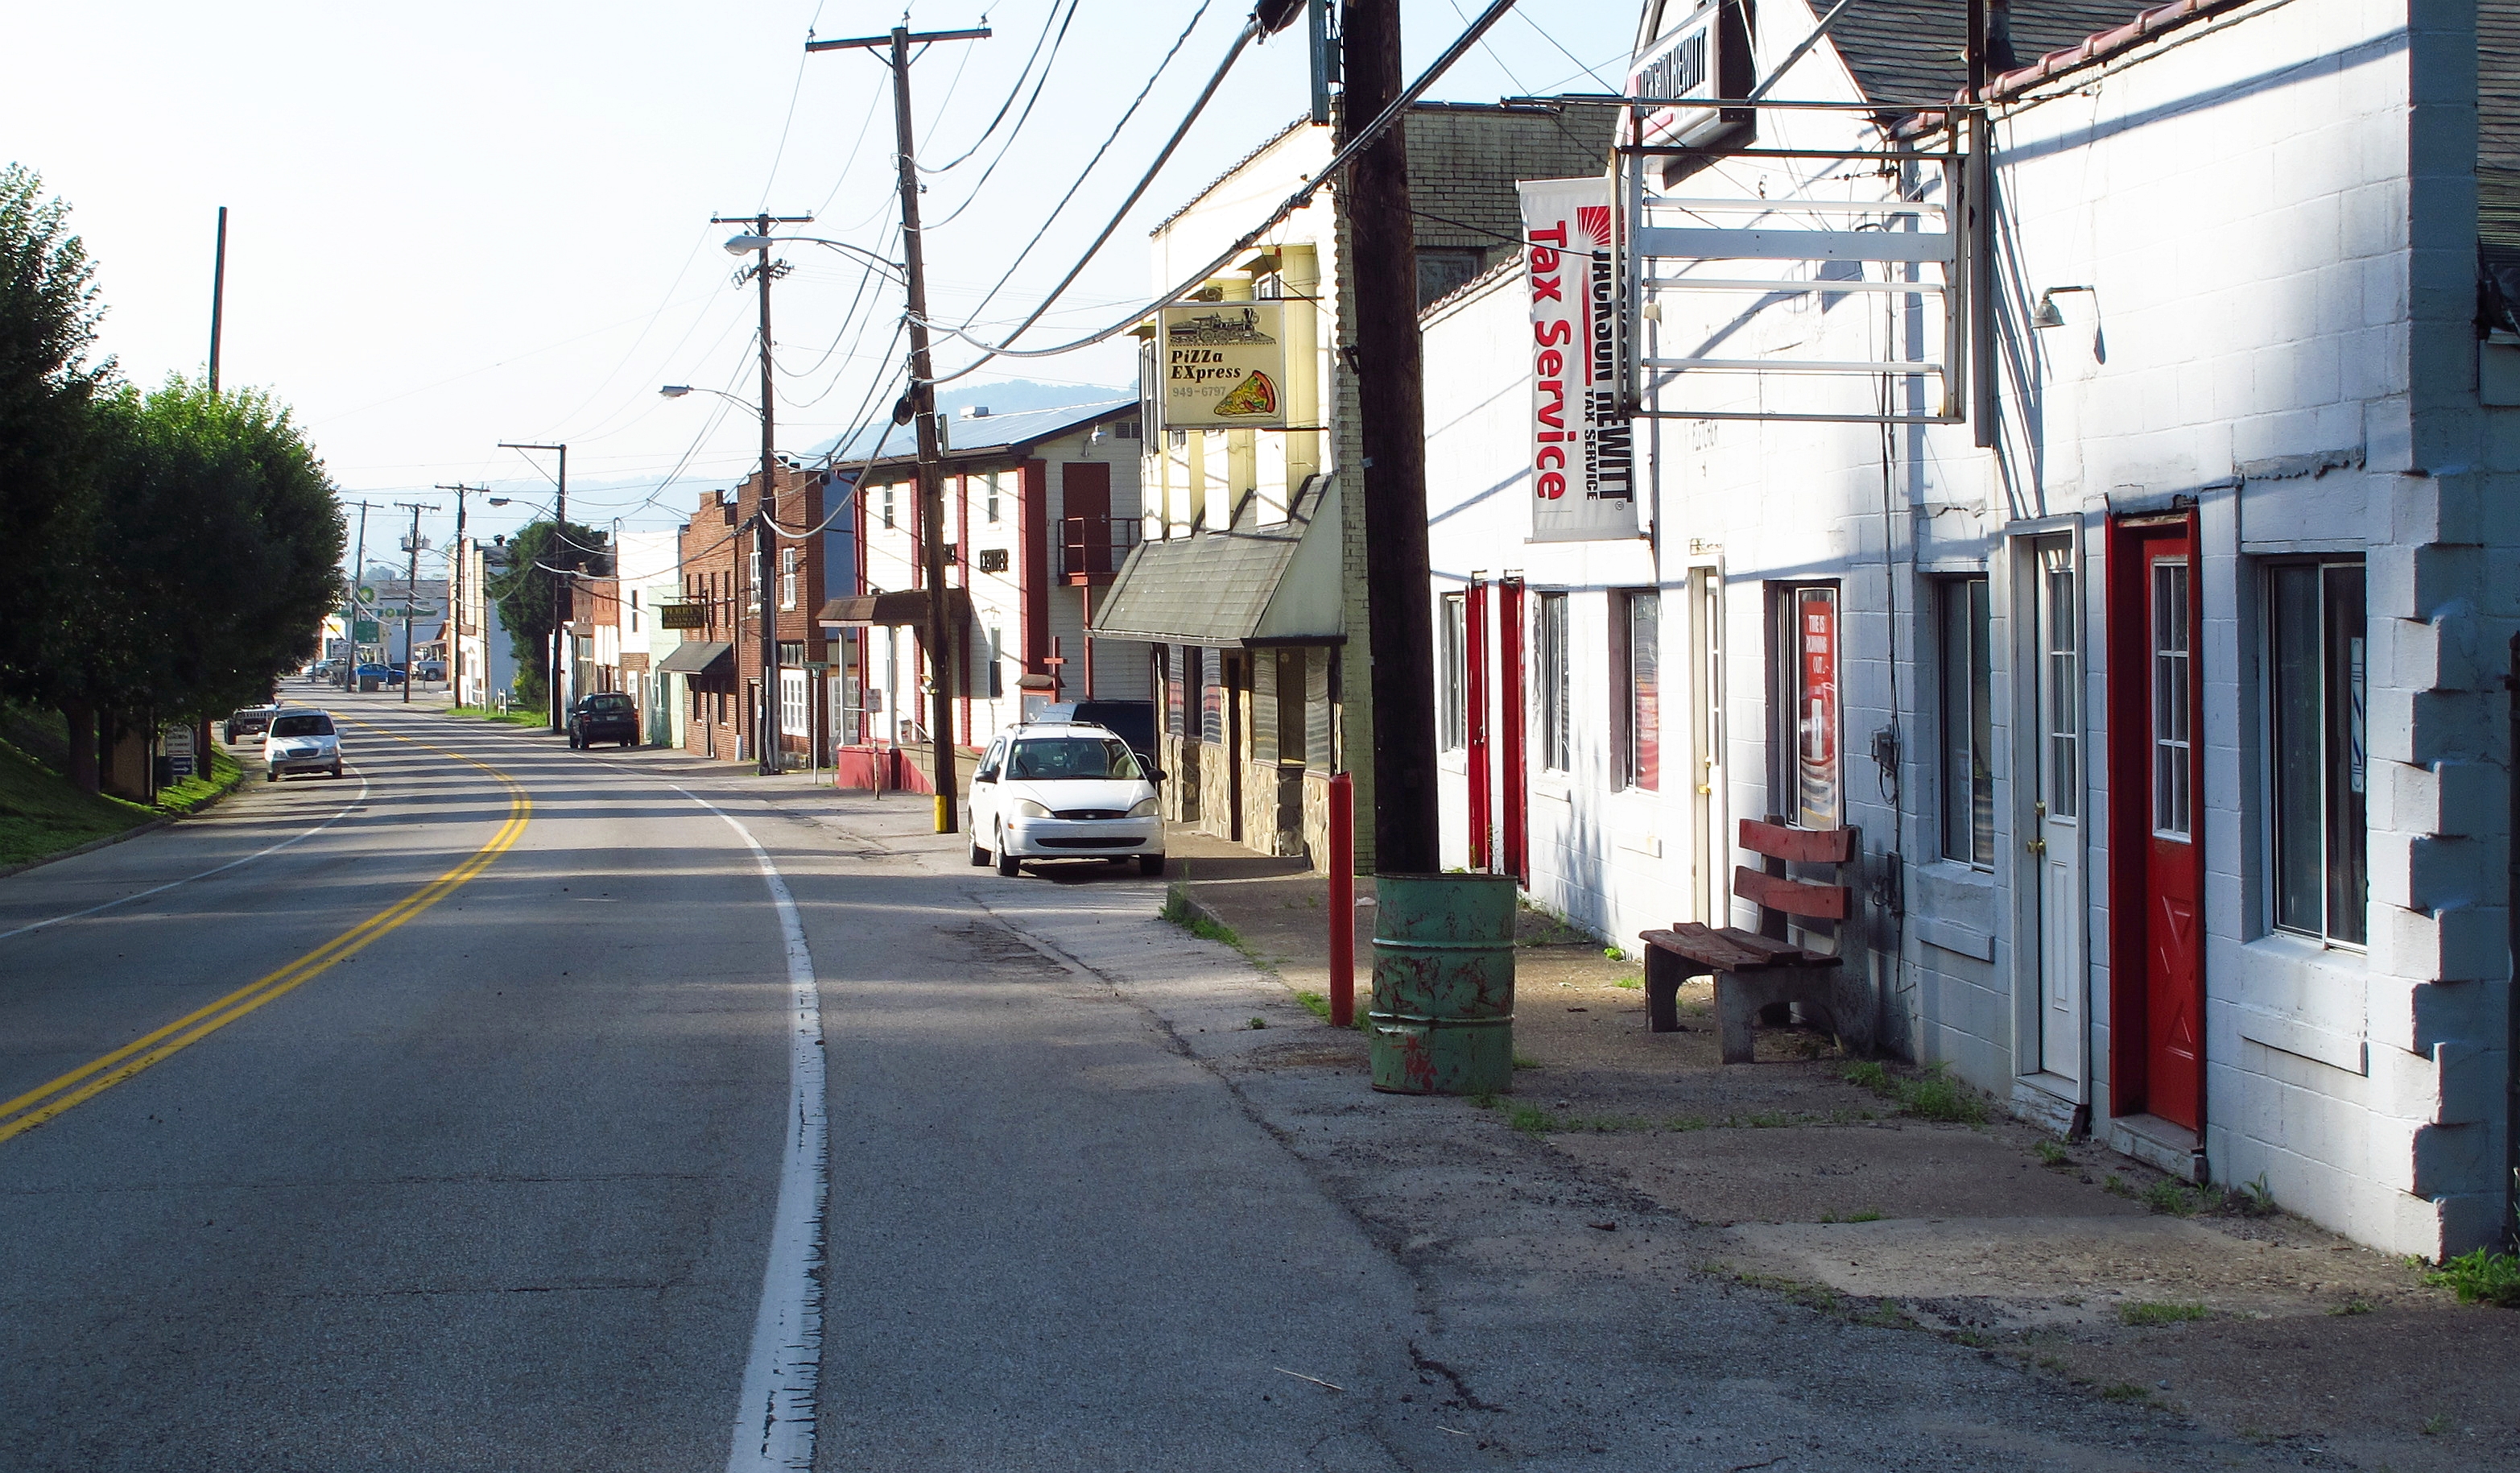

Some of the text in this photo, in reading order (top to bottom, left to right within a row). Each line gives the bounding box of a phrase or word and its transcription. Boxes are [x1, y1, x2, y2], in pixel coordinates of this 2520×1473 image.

[1530, 220, 1568, 304] Tax
[1172, 387, 1226, 397] 949-6797
[1535, 320, 1576, 500] Service
[1585, 389, 1598, 501] TAX SERVICE
